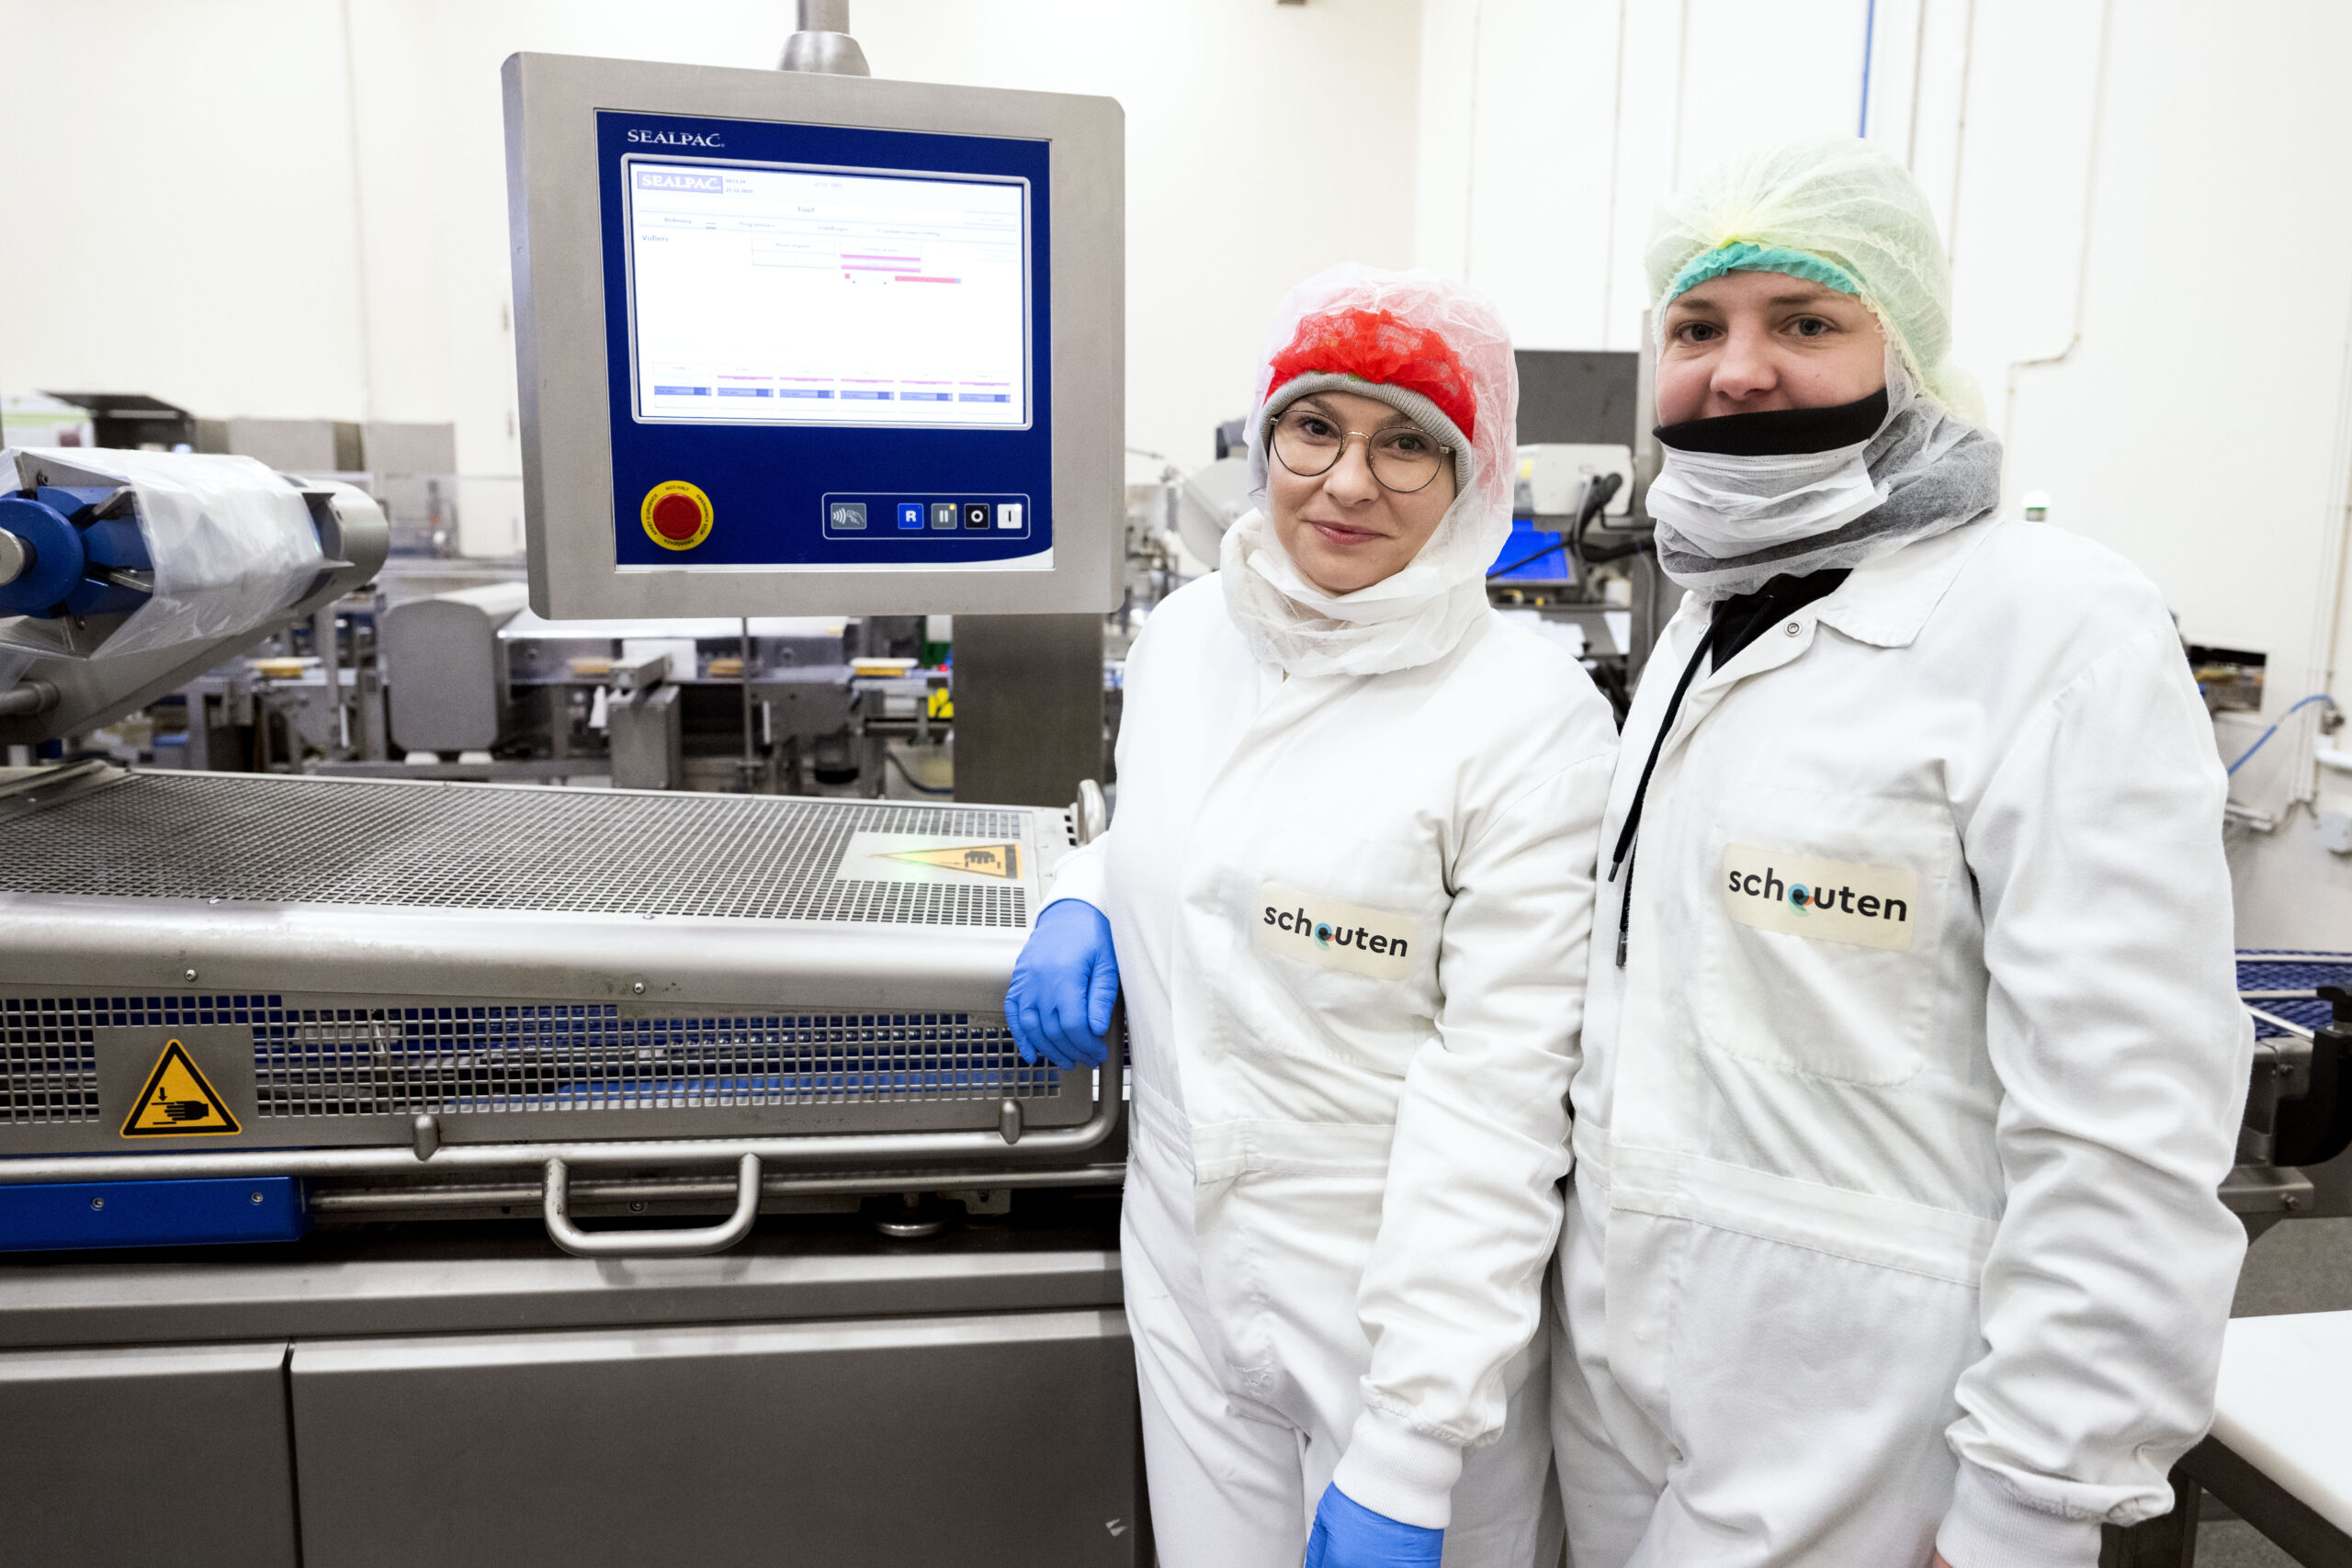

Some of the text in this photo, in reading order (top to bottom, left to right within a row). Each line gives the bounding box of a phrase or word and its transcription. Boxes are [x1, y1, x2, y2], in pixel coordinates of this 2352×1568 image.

[628, 130, 721, 147] SEALPAC
[641, 175, 721, 190] SEALPAC
[905, 510, 917, 522] R
[1728, 867, 1907, 921] schouten
[1263, 906, 1408, 957] schouten
